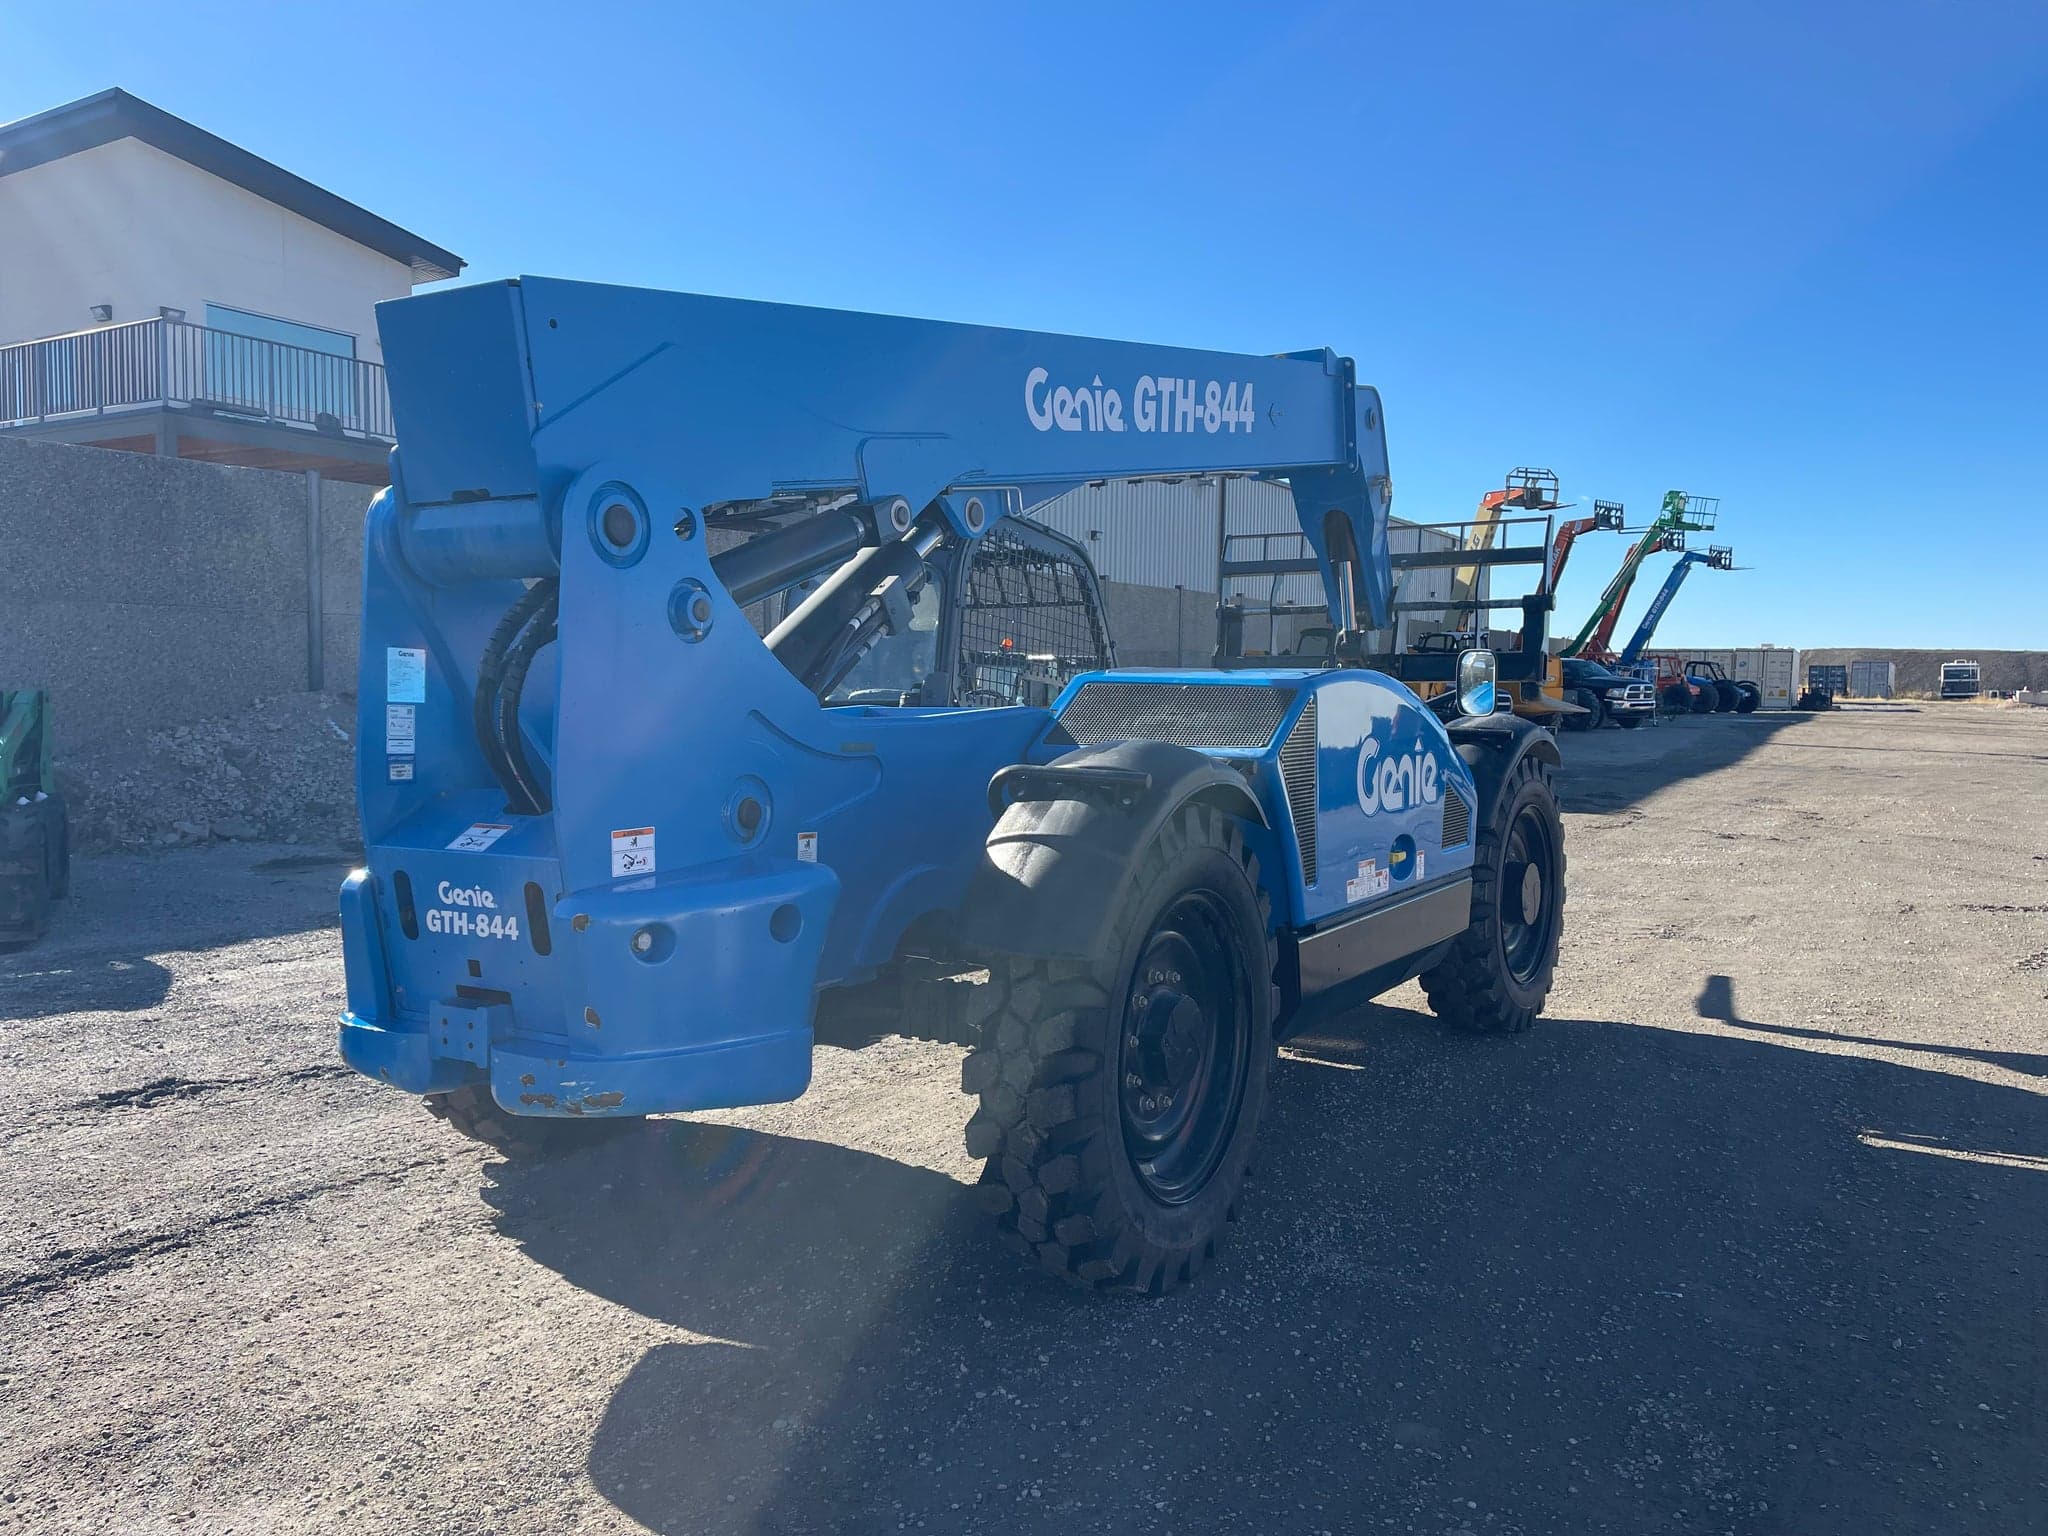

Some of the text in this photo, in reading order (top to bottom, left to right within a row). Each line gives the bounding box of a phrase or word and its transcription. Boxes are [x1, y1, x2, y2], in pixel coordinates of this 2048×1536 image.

[1025, 367, 1255, 434] Genie GTH-844
[1356, 737, 1438, 816] Genie
[438, 880, 497, 909] Genie
[426, 909, 520, 941] GTH-844
